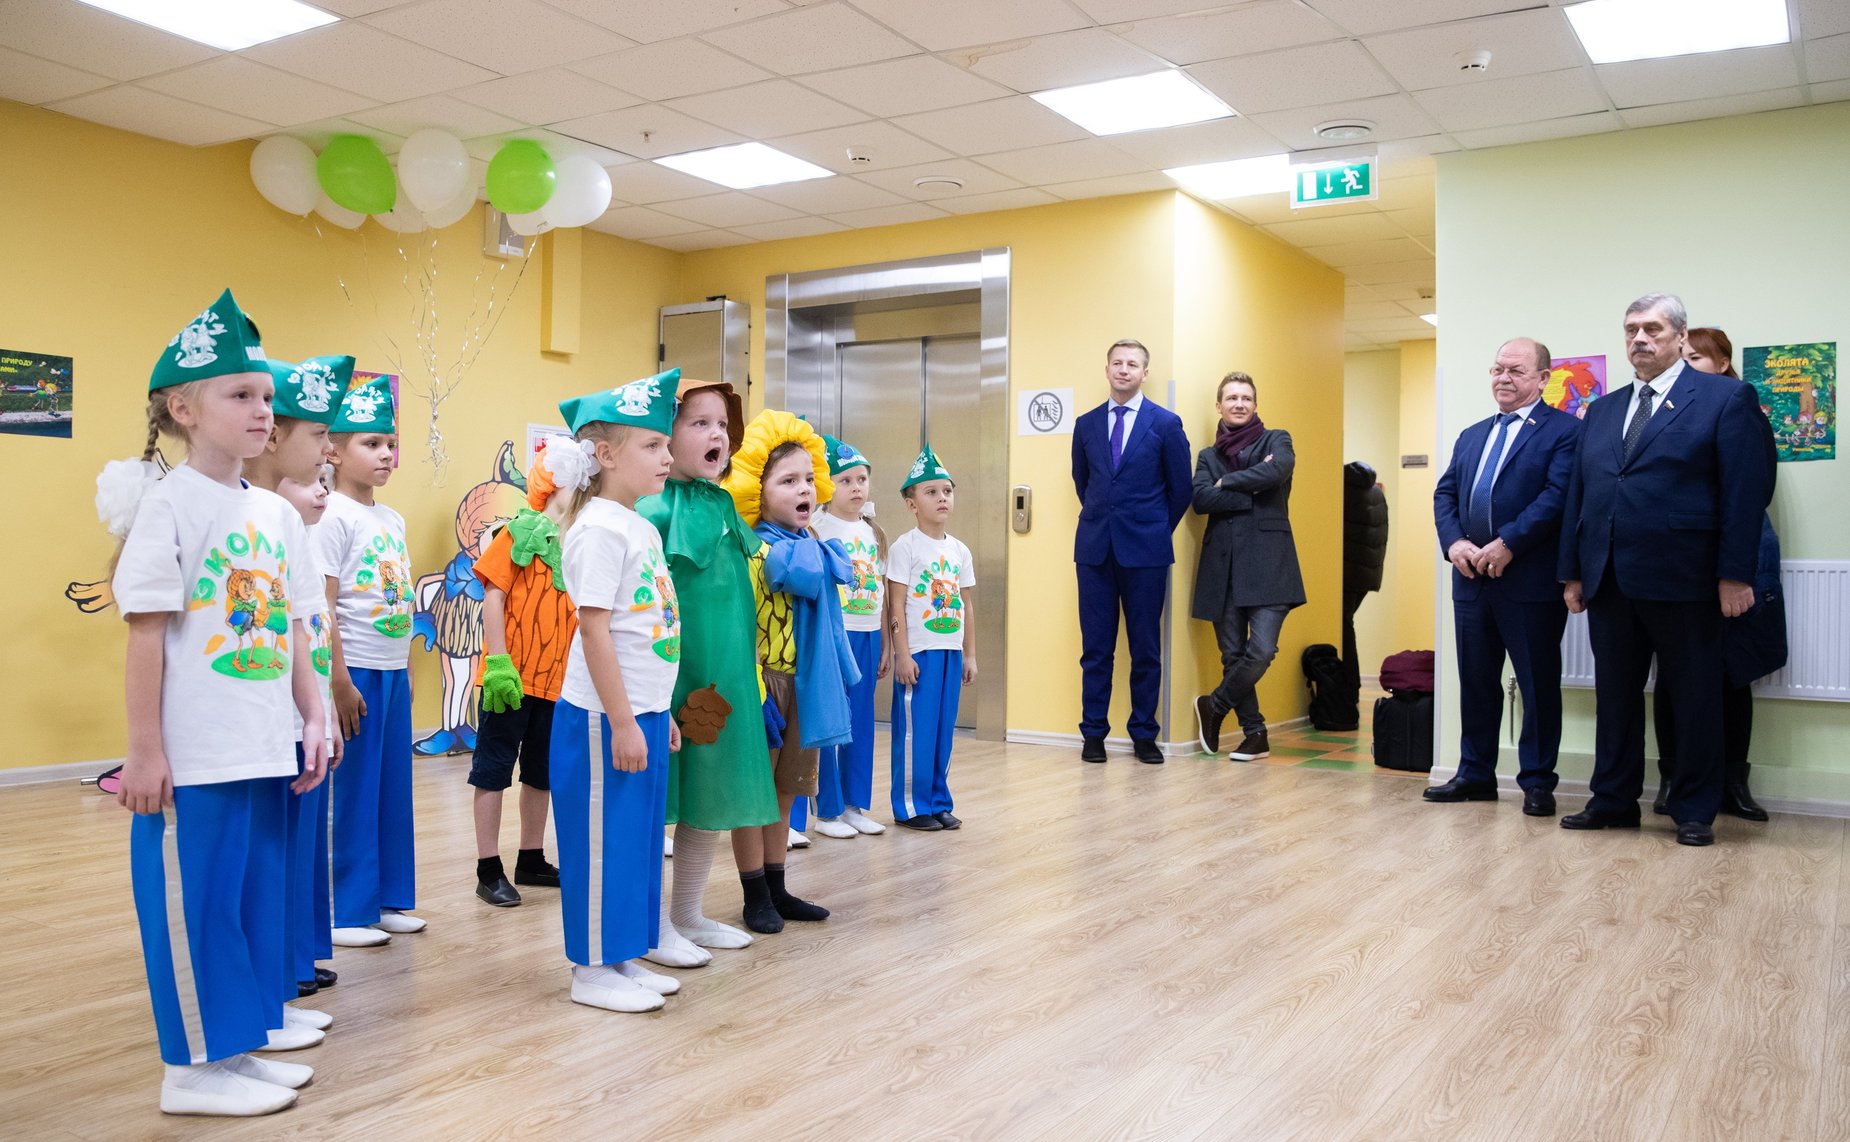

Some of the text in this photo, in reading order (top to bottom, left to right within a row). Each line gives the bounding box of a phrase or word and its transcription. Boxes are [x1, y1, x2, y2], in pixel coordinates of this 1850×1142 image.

[1, 356, 33, 367] ПРИРОДУ
[1764, 357, 1809, 368] ЭКОЛЯТА
[1772, 386, 1804, 394] ПРИРОДЫ
